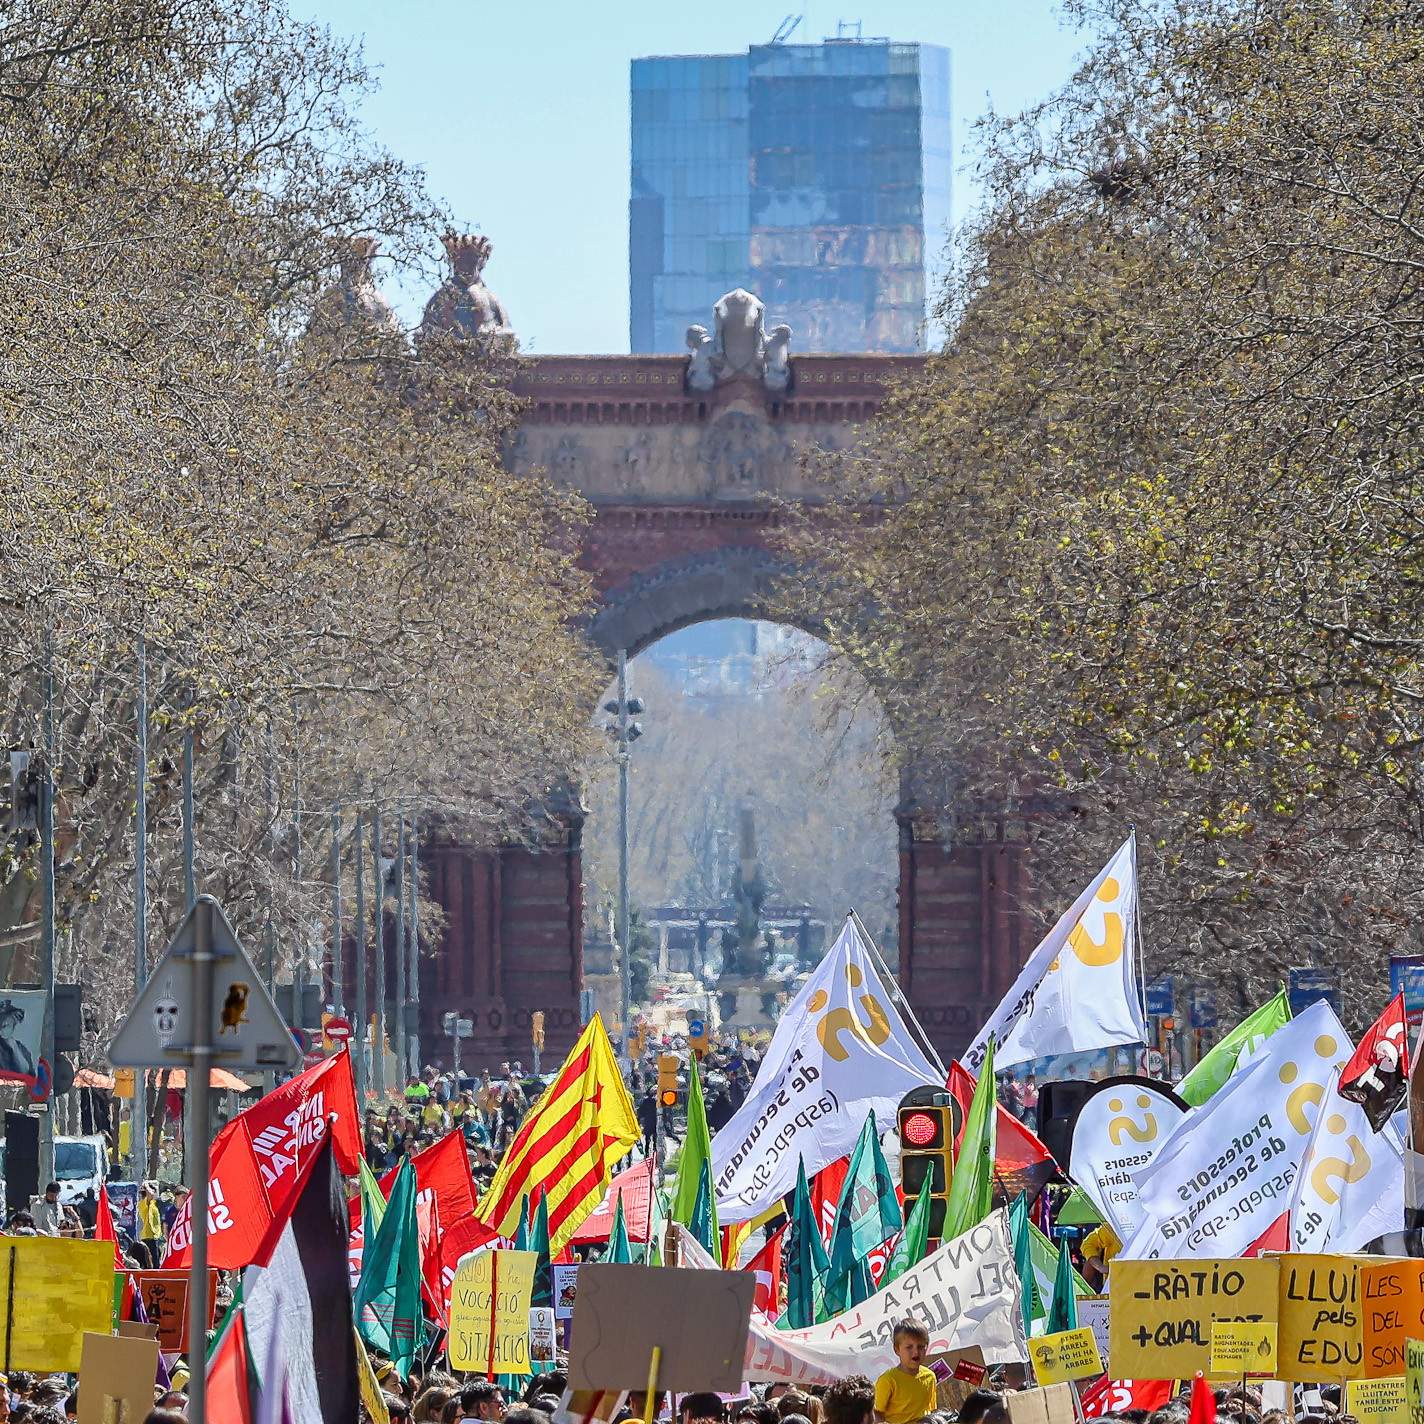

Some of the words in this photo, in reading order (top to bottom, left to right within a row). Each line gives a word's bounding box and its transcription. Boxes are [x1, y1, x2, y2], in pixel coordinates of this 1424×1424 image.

[1365, 1275, 1403, 1299] LES
[1312, 1304, 1358, 1332] pels
[1372, 1310, 1404, 1333] DEL
[1060, 1333, 1085, 1345] SENSE
[1060, 1340, 1089, 1352] ARRELS
[1059, 1353, 1072, 1362] NO
[1072, 1352, 1081, 1361] HI
[1082, 1349, 1094, 1358] HA
[1372, 1341, 1406, 1368] SÓN
[1064, 1357, 1094, 1371] ARBRES
[1356, 1383, 1369, 1391] LES
[1370, 1382, 1405, 1390] MESTRES
[1412, 1377, 1421, 1396] A
[1362, 1390, 1399, 1398] LLUITANT
[1381, 1397, 1407, 1406] ESTEM
[1363, 1405, 1398, 1413] EDUCANT
